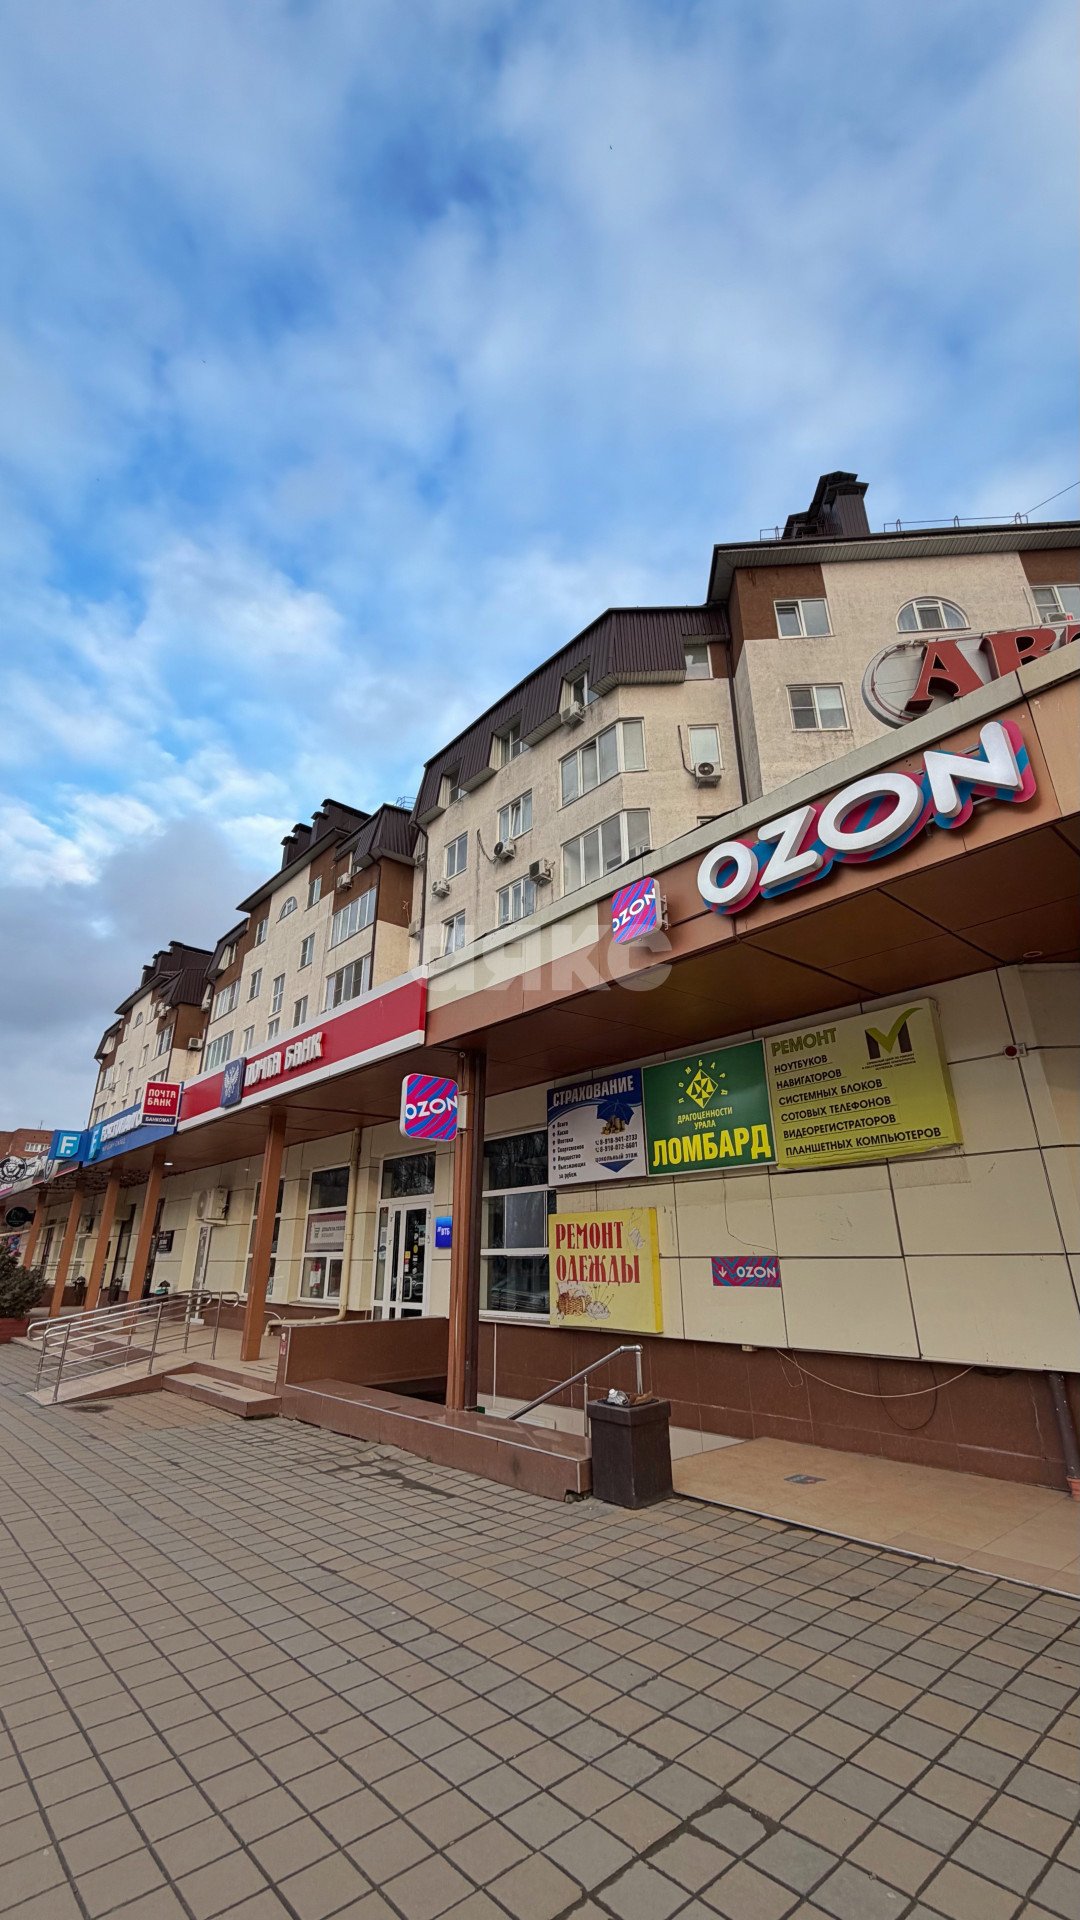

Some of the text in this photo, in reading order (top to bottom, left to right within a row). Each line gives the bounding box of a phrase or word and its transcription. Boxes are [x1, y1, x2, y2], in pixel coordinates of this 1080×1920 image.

[697, 721, 1024, 905] OZON
[284, 1031, 323, 1070] БАНК
[771, 1027, 837, 1057] РЕМОНТ
[774, 1054, 828, 1074] НОУТБУКОВ
[553, 1075, 634, 1107] СТРАХОВАНИЕ
[776, 1068, 842, 1090] НАВИГАТОРОВ
[778, 1078, 883, 1106] СИСТЕМНЫХ БЛОКОВ
[147, 1098, 171, 1107] БАНК
[148, 1089, 176, 1098] ПОЧТА
[405, 1095, 458, 1120] OZON
[677, 1106, 733, 1124] ДРАГОЦЕННОСТИ
[781, 1095, 891, 1122] СОТОВЫХ ТЕЛЕФОНОВ
[694, 1119, 716, 1130] УРАЛА
[783, 1113, 896, 1140] ВИДЕОРЕГИСТРАТОРОВ
[652, 1123, 772, 1167] ЛОМБАРД
[785, 1127, 942, 1157] ПЛАНШЕТНЫХ КОМПЬЮТЕРОВ
[555, 1221, 624, 1250] РЕМОНТ
[556, 1254, 641, 1286] ОДЕЖДЫ
[736, 1266, 777, 1279] OZON
